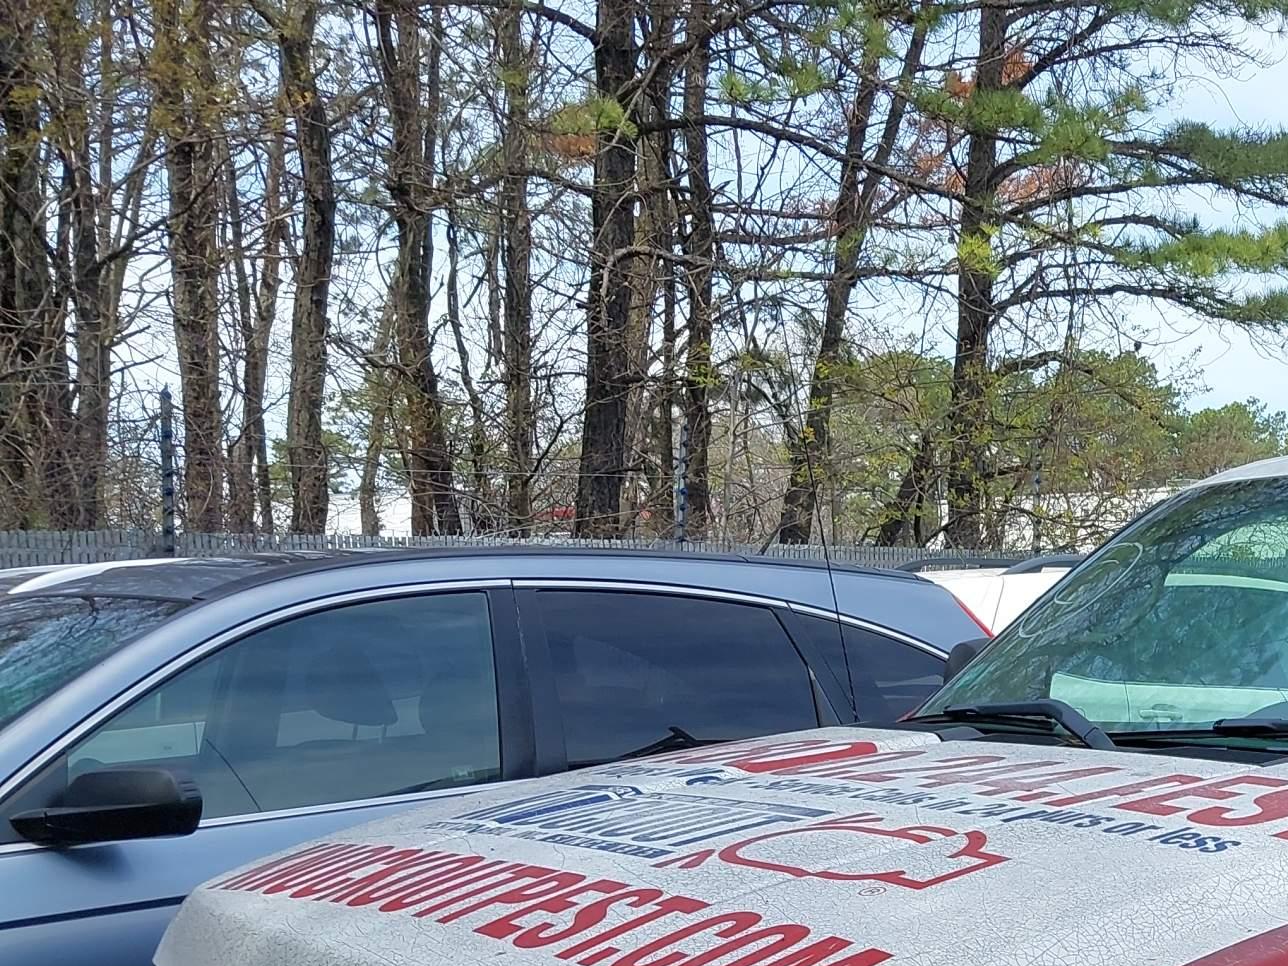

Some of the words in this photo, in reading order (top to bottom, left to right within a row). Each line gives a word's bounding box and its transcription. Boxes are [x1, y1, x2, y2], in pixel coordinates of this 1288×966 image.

[750, 779, 865, 796] Service
[848, 788, 938, 805] Calls
[920, 797, 973, 811] in
[955, 803, 1028, 818] 24
[1102, 822, 1166, 836] or
[1147, 827, 1242, 853] less
